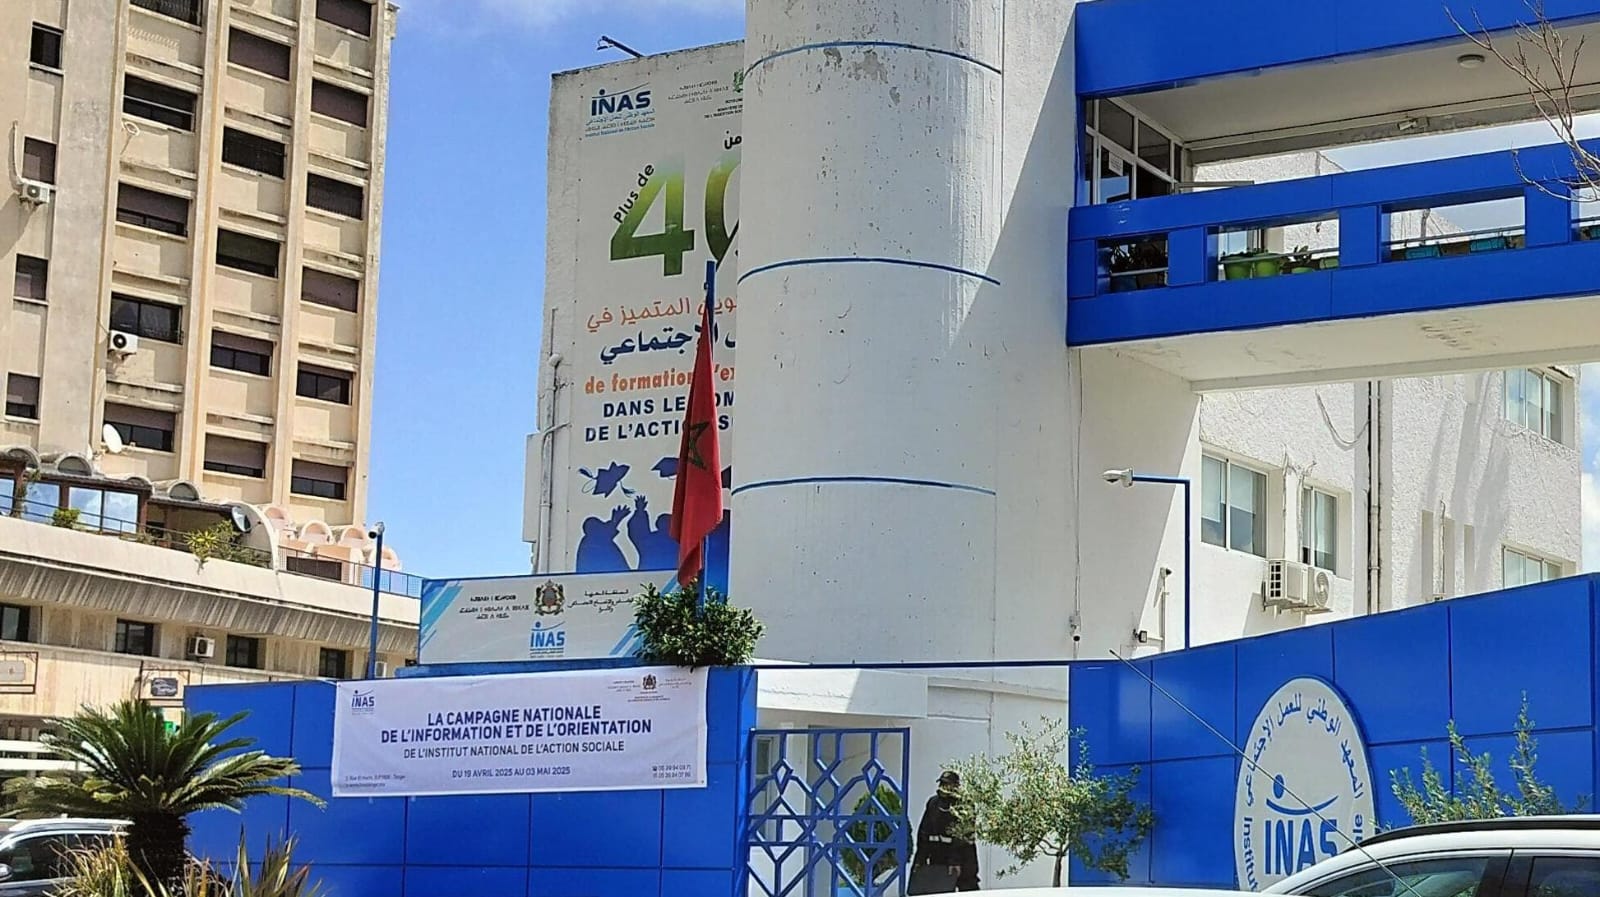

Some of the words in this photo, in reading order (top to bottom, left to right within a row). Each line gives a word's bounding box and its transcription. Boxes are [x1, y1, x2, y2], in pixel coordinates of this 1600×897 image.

[592, 90, 651, 116] INAS
[613, 190, 639, 224] Plus
[637, 164, 655, 187] de
[587, 306, 613, 333] في
[620, 297, 690, 326] المتميز
[585, 376, 605, 394] de
[603, 399, 655, 418] DANS
[663, 396, 686, 412] LE
[585, 426, 609, 442] DE
[618, 419, 685, 439] L'ACTI
[531, 631, 565, 647] INAS
[352, 696, 374, 707] INAS
[1277, 693, 1301, 726] للعمل
[428, 713, 443, 726] LA
[447, 709, 520, 725] CAMPAGNE
[523, 706, 601, 722] NATIONALE
[1307, 698, 1341, 736] الوطني
[381, 730, 398, 743] DE
[401, 726, 501, 742] L'INFORMATION
[506, 725, 522, 738] ET
[526, 724, 543, 738] DE
[547, 719, 652, 736] L'ORIENTATION
[404, 748, 416, 758] DE
[418, 746, 468, 758] L'INSTITUT
[470, 744, 519, 756] NATIONAL
[521, 744, 533, 754] DE
[536, 742, 579, 754] L'ACTION
[582, 741, 624, 752] SOCIALE
[452, 770, 462, 778] DU
[464, 769, 472, 778] 19
[473, 769, 493, 777] AVRIL
[495, 768, 512, 777] 2025
[514, 768, 524, 776] AU
[526, 767, 535, 775] 03
[537, 767, 551, 775] MAI
[552, 766, 570, 775] 2025
[1341, 739, 1364, 799] المعهد
[1265, 818, 1337, 876] INAS
